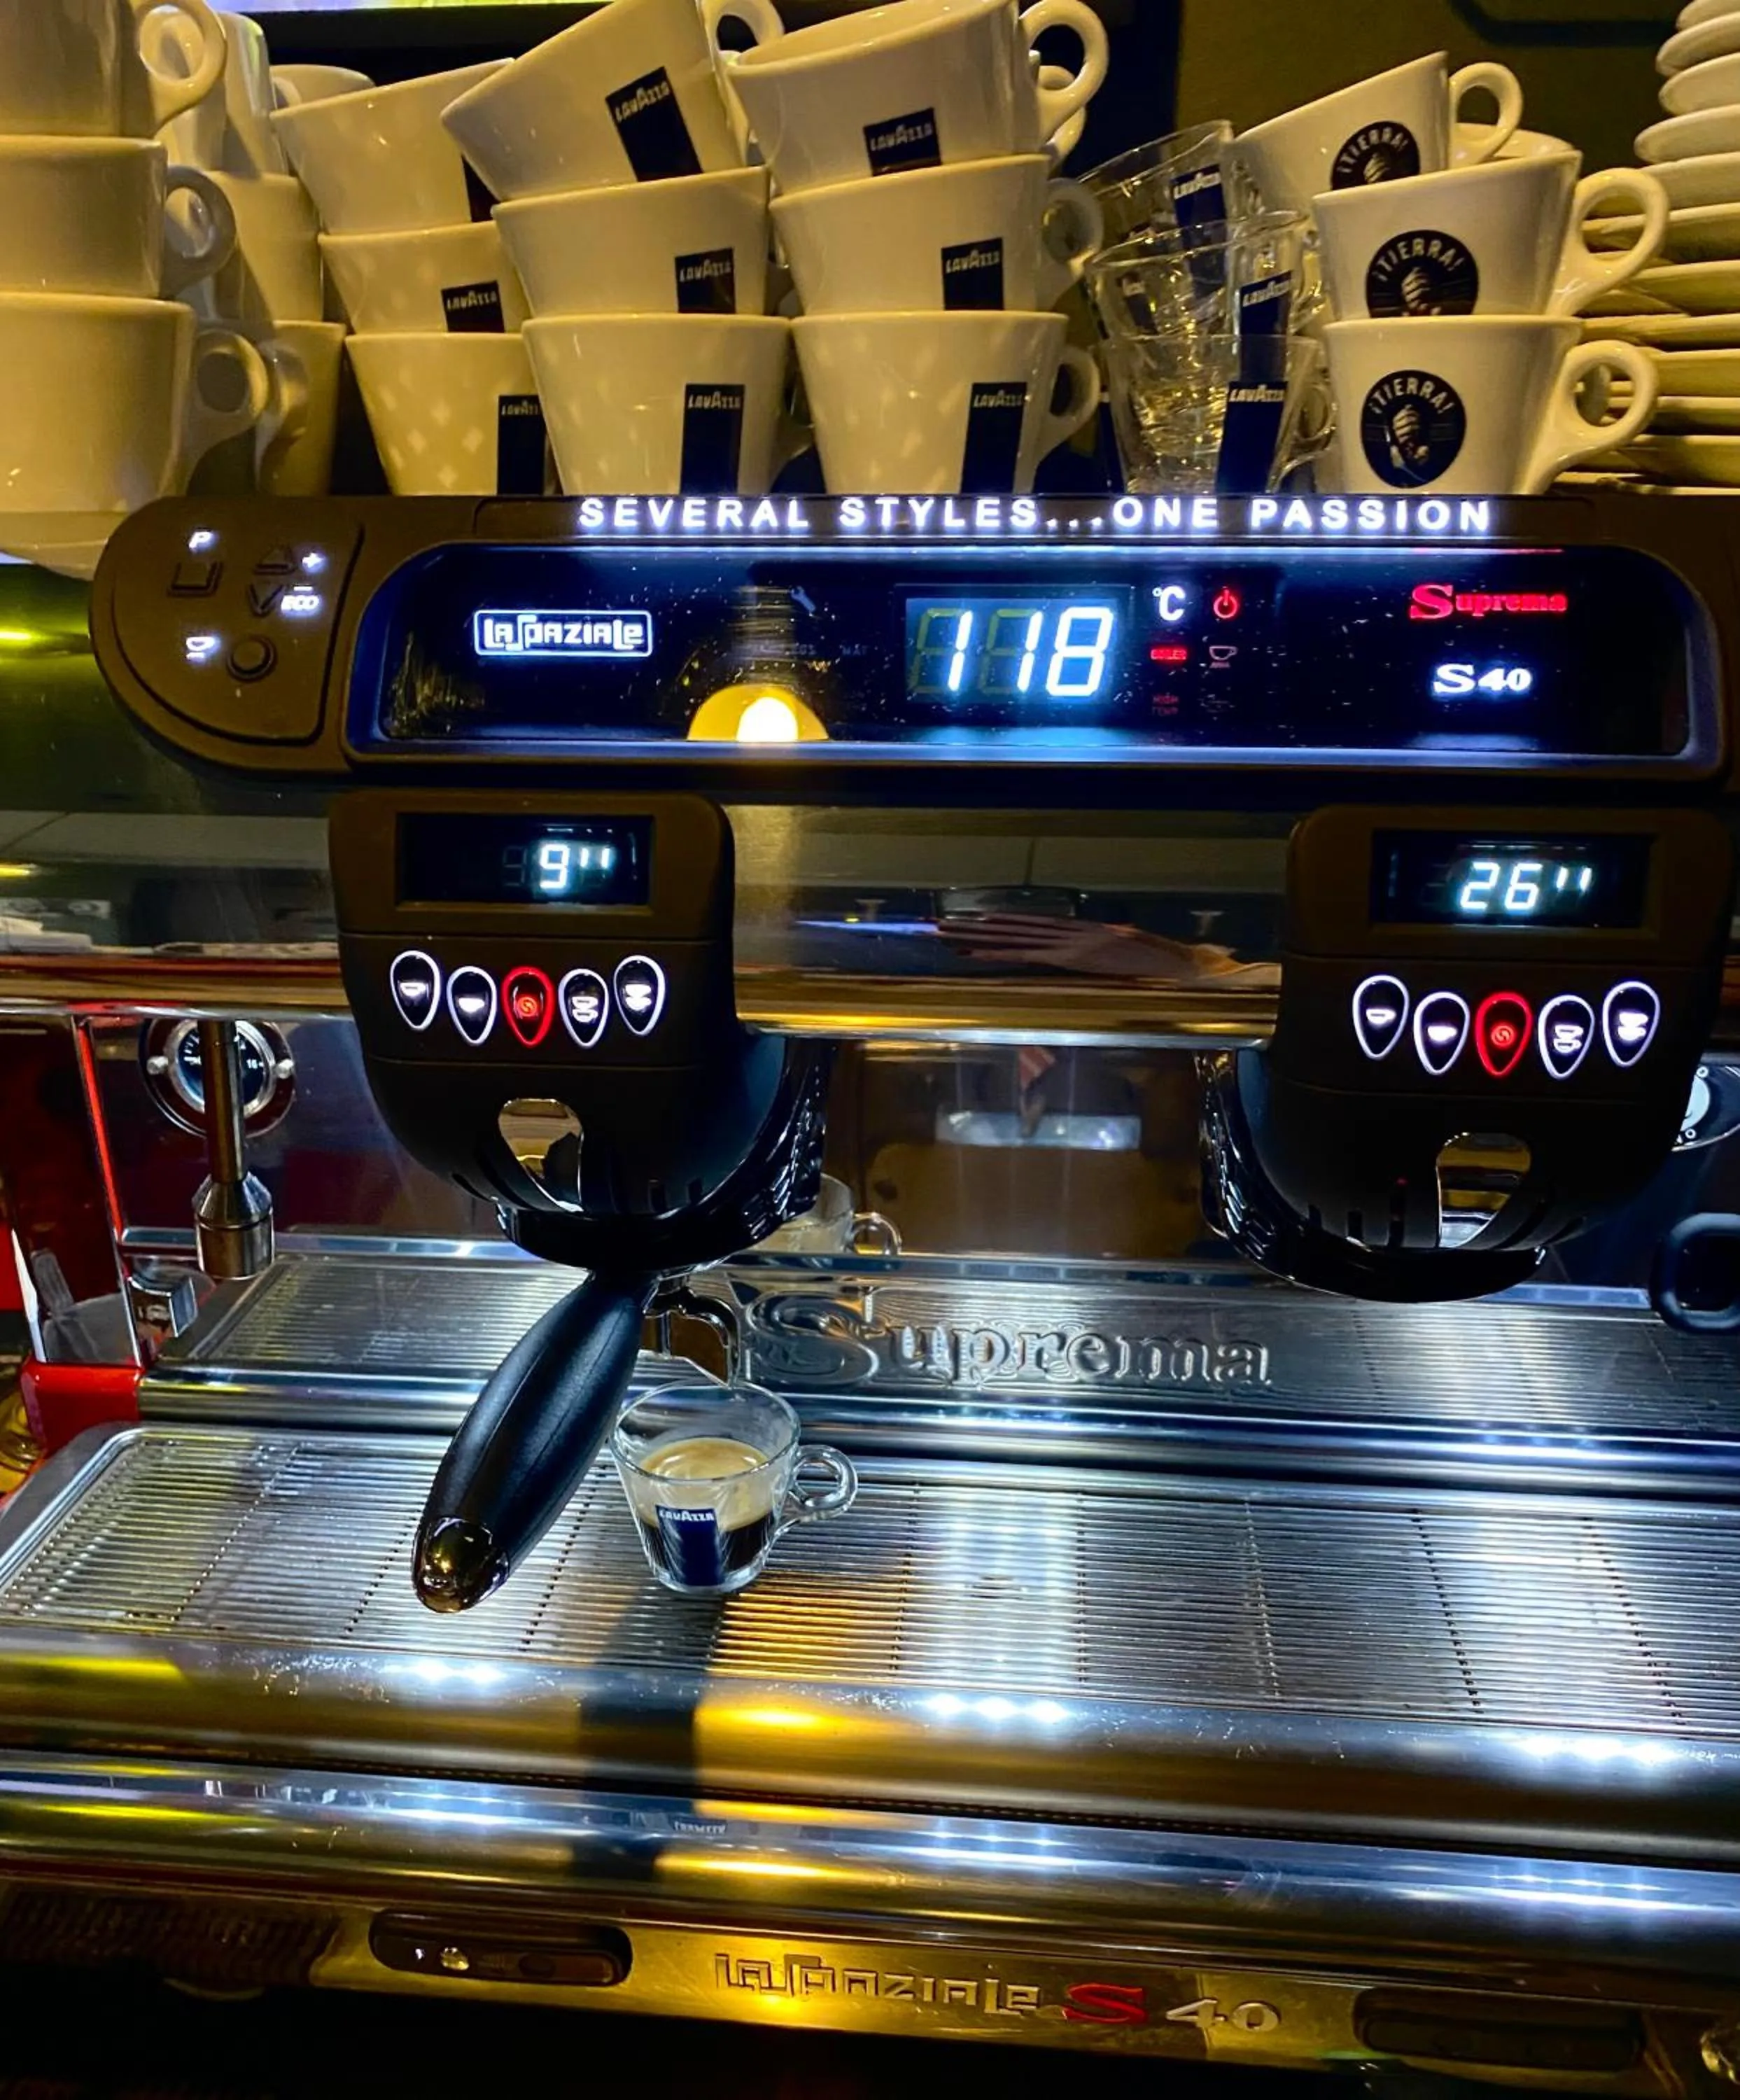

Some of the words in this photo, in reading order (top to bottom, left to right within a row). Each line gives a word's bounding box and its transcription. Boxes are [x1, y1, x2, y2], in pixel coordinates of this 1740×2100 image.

[615, 79, 672, 122] LAVAZZA
[870, 122, 934, 151] LAVAZZA
[679, 258, 732, 283] LAVAZZA
[945, 249, 1000, 274] LAVAZZA
[446, 289, 498, 311] LAVAZZA
[687, 391, 741, 410] LAVAZZA
[973, 389, 1023, 407] LAVAZZA
[578, 497, 810, 528] SEVERAL
[1251, 499, 1491, 531] PASSION
[1409, 584, 1568, 620] Suprema
[947, 606, 1114, 697] 118
[746, 1290, 1274, 1389] Suprema
[659, 1509, 716, 1522] LAVAZZA
